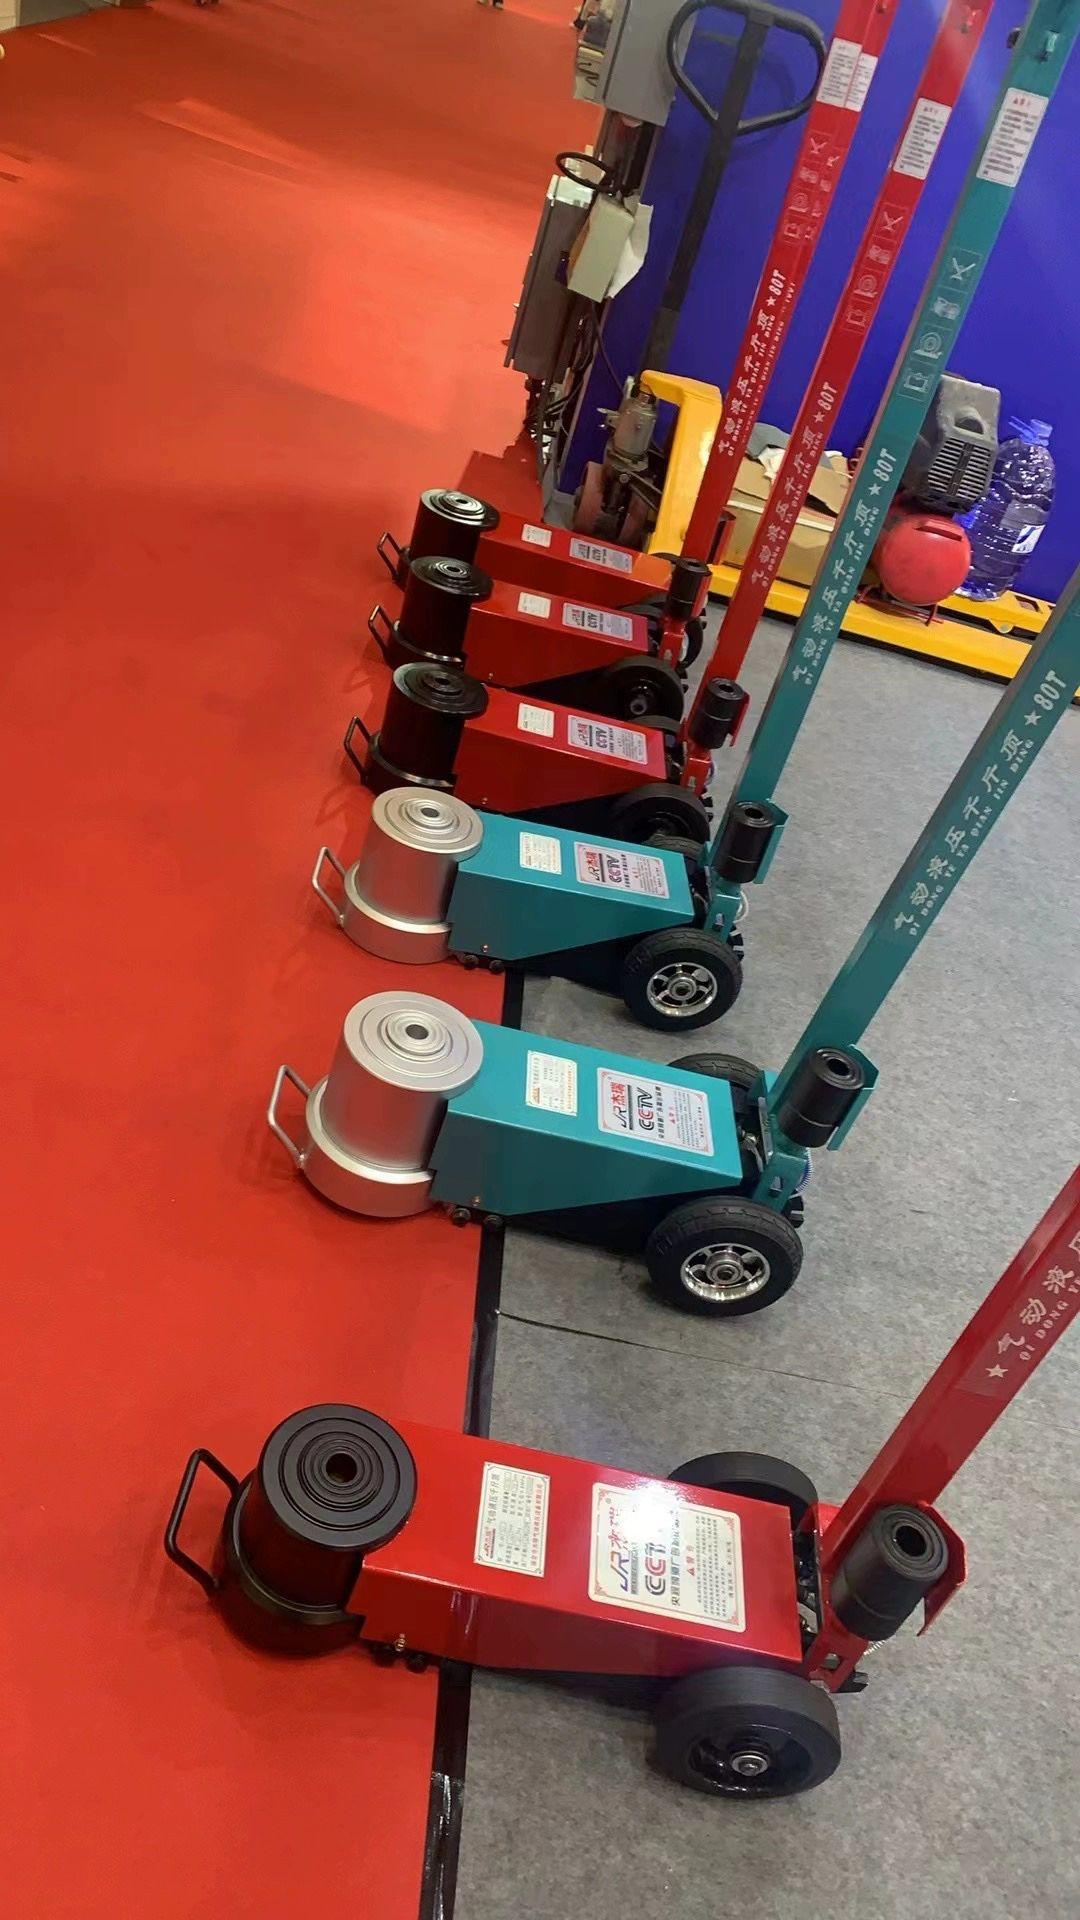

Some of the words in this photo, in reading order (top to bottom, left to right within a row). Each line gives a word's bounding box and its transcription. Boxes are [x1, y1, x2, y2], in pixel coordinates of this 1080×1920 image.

[768, 269, 786, 296] 80T
[817, 381, 837, 411] 80T
[873, 448, 896, 482] 80T
[895, 730, 1022, 928] 气动液压千斤顶
[1033, 670, 1066, 710] 80T
[920, 885, 944, 916] DONG
[1009, 739, 1034, 773] DING
[606, 854, 622, 883] CCTV
[637, 1087, 655, 1131] CCTV
[1035, 1300, 1069, 1339] DONG
